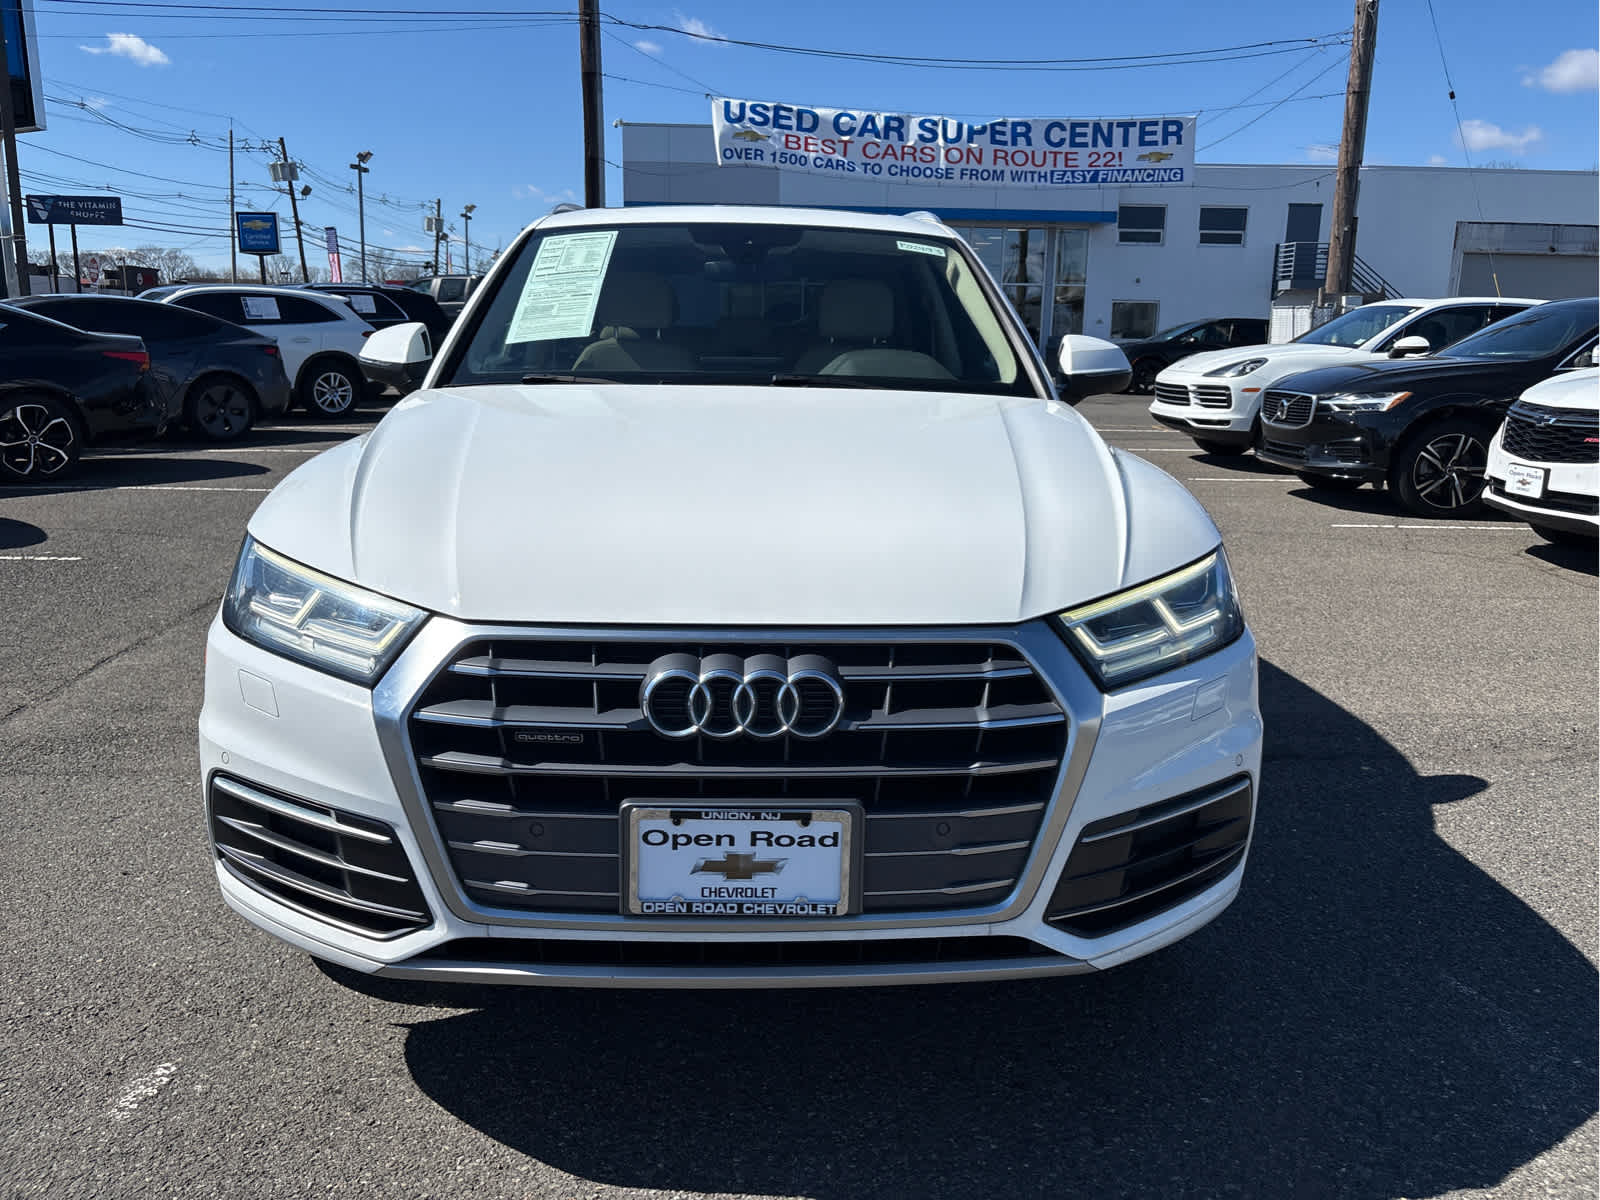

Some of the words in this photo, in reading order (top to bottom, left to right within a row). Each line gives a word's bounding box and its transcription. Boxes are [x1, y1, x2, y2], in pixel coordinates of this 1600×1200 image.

[723, 100, 819, 134] USED
[832, 112, 905, 142] CAR
[917, 118, 1033, 147] SUPER
[1044, 119, 1184, 148] CENTER
[784, 133, 854, 157] BEST
[861, 142, 936, 164] CARS
[944, 147, 983, 166] ON
[992, 150, 1079, 168] ROUTE
[1087, 151, 1123, 168] 22!
[722, 147, 764, 161] OVER
[770, 152, 807, 167] 1500
[812, 156, 857, 173] CARS
[861, 162, 883, 176] TO
[887, 164, 955, 180] CHOOSE
[960, 167, 1005, 182] FROM
[1010, 170, 1048, 183] WITH
[1053, 170, 1094, 183] EASY
[1098, 168, 1182, 183] FINANCING
[57, 201, 75, 209] THE
[77, 201, 116, 209] VITAMIN
[70, 210, 105, 219] SHOPPE
[518, 734, 580, 742] quattro
[760, 812, 781, 820] NJ
[641, 829, 736, 851] Open
[749, 830, 840, 848] Road
[700, 886, 778, 899] CHEVROLET
[643, 902, 687, 913] OPEN
[692, 902, 738, 914] ROAD
[742, 903, 838, 915] CHEVROLET
